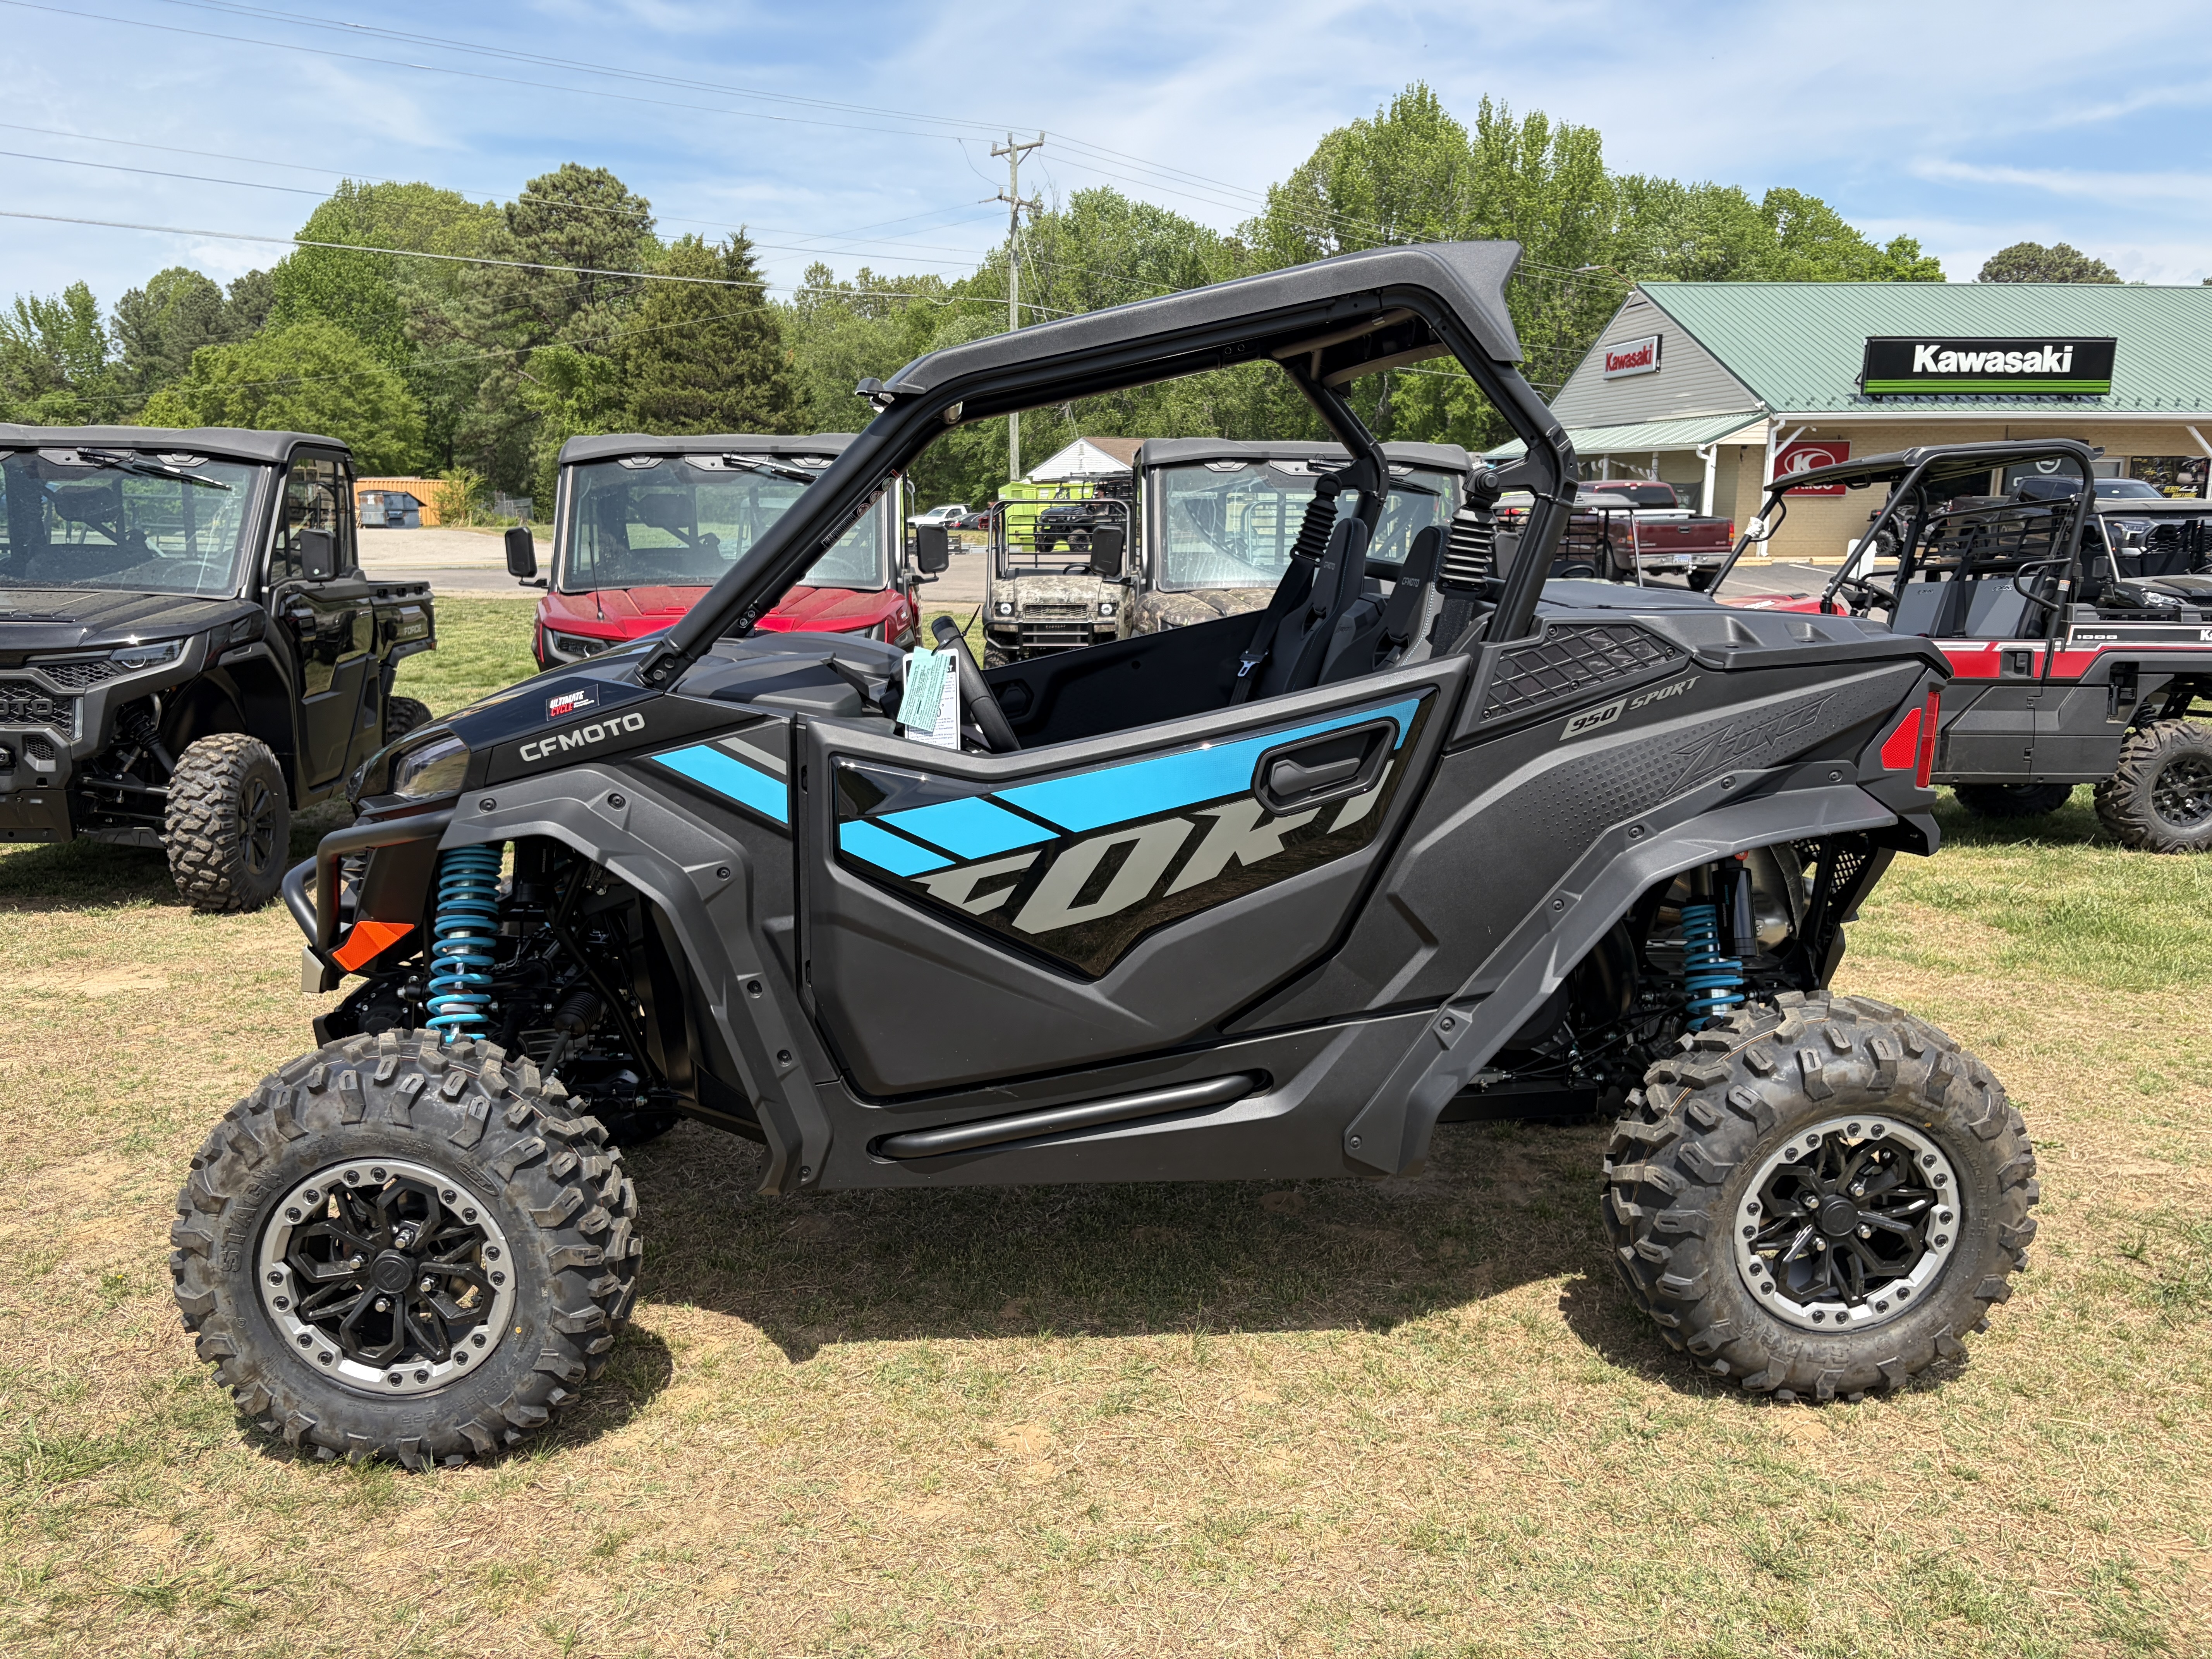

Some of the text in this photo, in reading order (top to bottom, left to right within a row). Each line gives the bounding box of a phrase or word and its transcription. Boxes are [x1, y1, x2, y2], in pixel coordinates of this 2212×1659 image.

[1605, 343, 1653, 372] Kawasaki
[1913, 344, 2073, 374] Kawasaki
[1401, 577, 1420, 588] CFMOTO
[404, 624, 422, 635] FORCE
[550, 690, 585, 709] ULTIMATE
[1628, 676, 1702, 711] SPORT
[550, 702, 574, 716] CYCLE
[1571, 706, 1619, 732] 950
[520, 712, 646, 762] CFMOTO
[462, 1166, 491, 1188] CST
[218, 1182, 271, 1273] STAG
